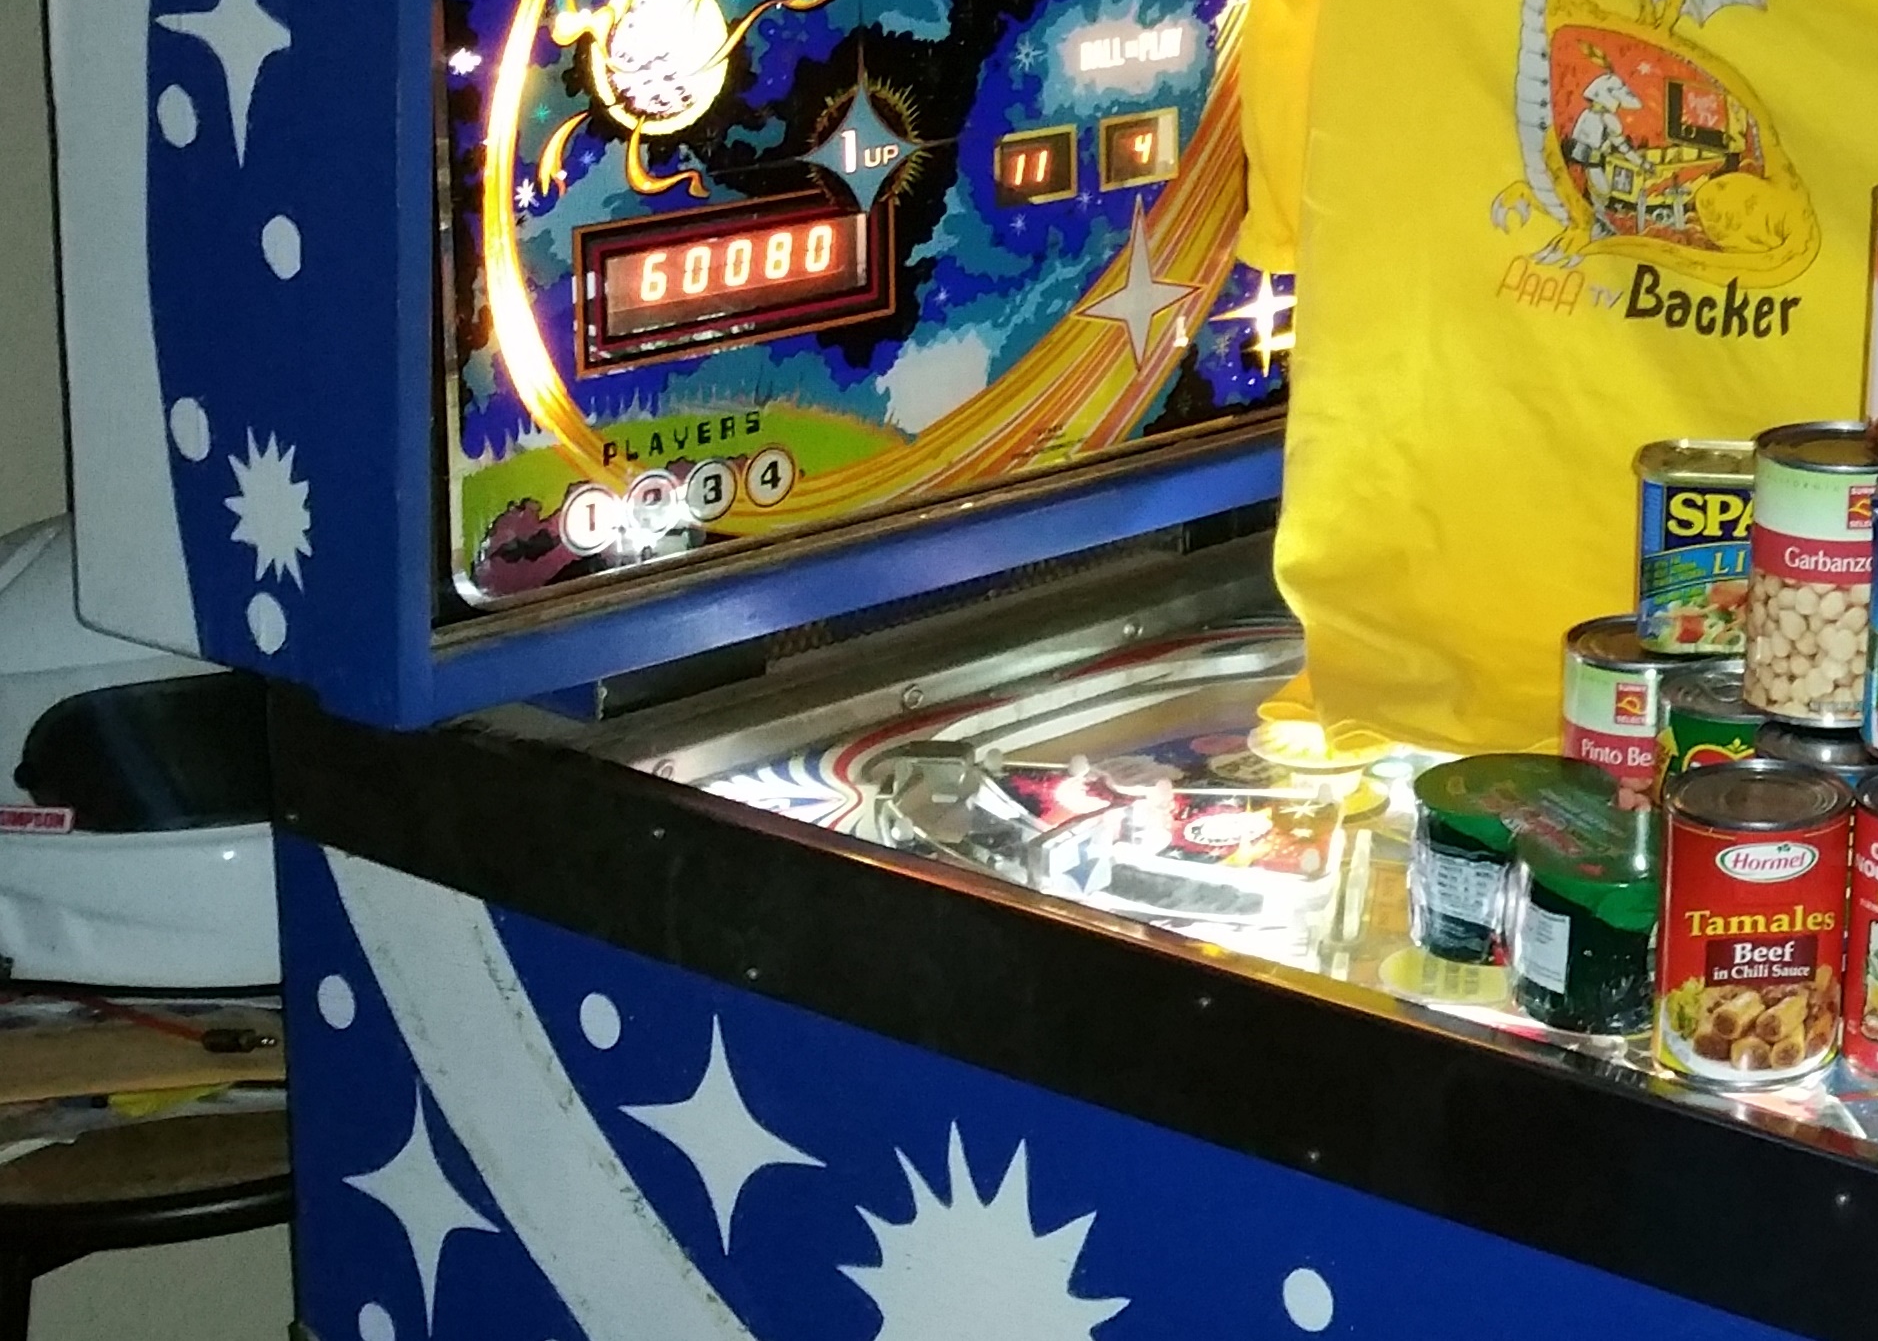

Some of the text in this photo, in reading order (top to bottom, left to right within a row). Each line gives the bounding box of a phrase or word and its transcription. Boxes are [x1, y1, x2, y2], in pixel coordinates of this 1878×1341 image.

[1134, 132, 1152, 164] 4
[1014, 150, 1048, 186] 11
[639, 224, 833, 302] 60080
[1624, 262, 1802, 338] Backer
[602, 411, 761, 467] PLAYERS
[703, 474, 722, 505] 3
[760, 460, 781, 490] 4
[1667, 492, 1754, 537] SPA
[1712, 549, 1749, 575] LI
[1581, 738, 1653, 767] Pinto Be
[1731, 851, 1807, 871] Hormel
[1684, 905, 1836, 937] Tamales
[1733, 940, 1796, 964] Beef
[1712, 964, 1811, 980] in Chili Sauce
